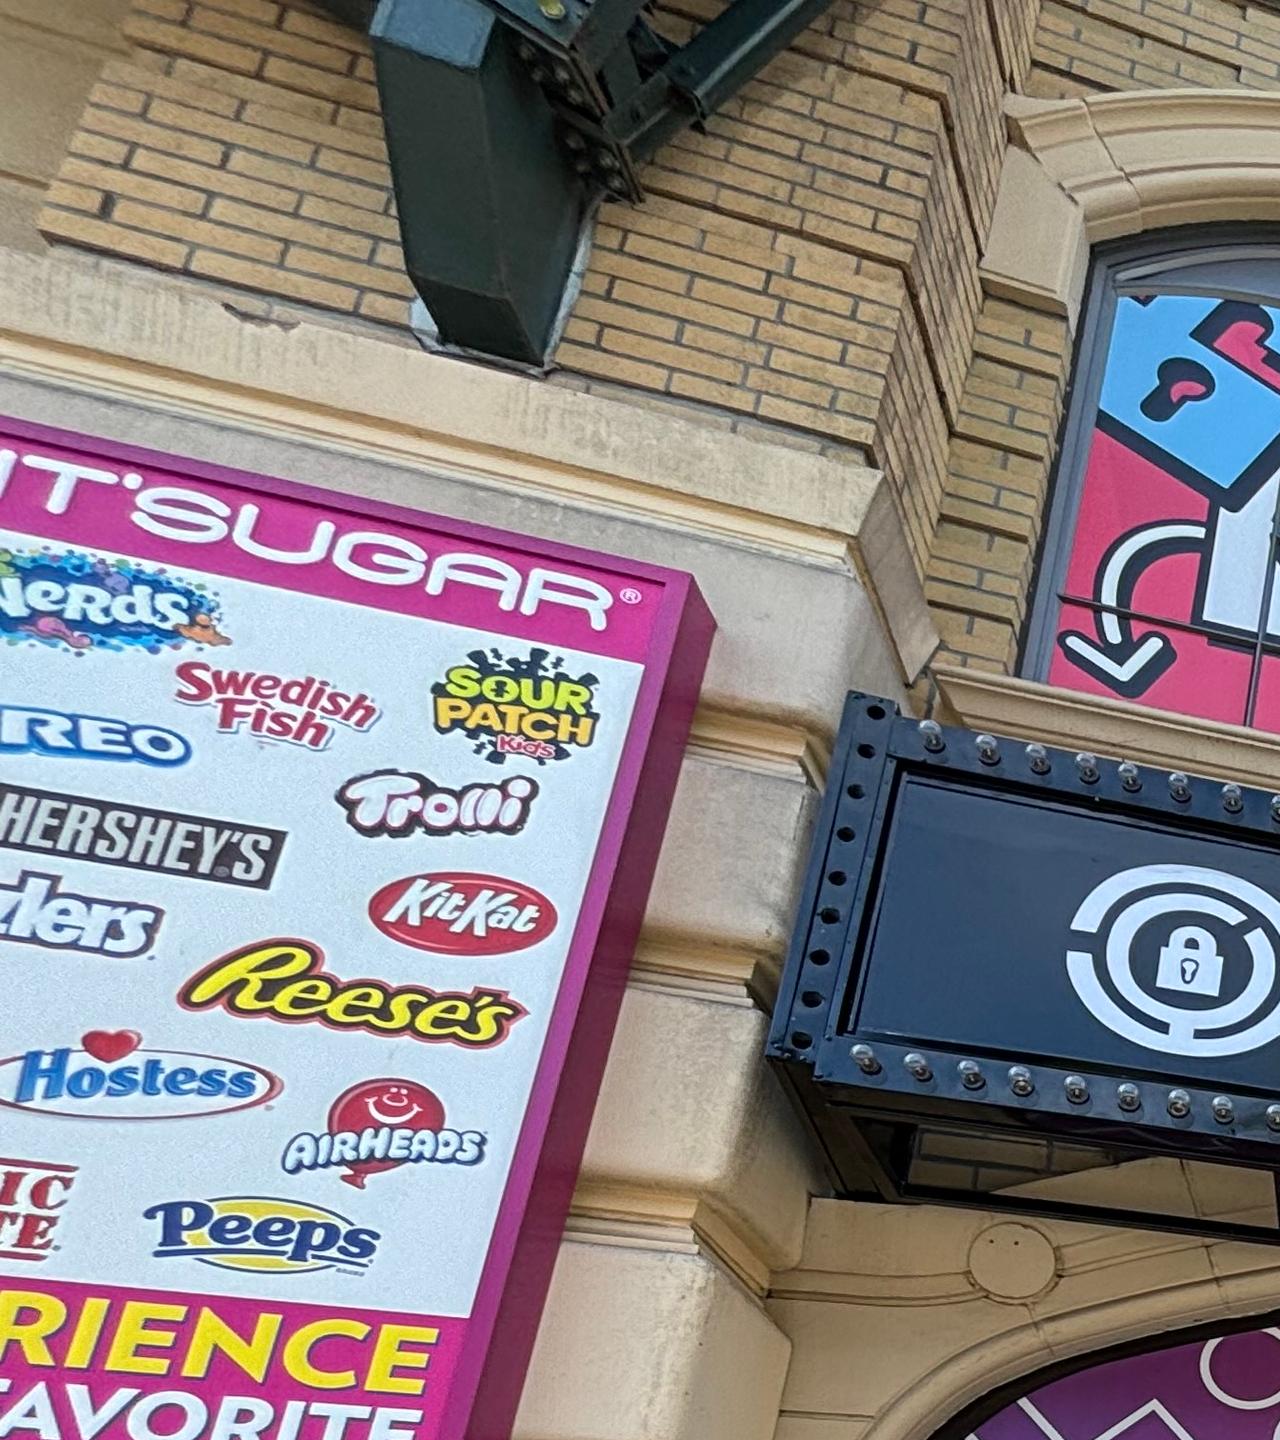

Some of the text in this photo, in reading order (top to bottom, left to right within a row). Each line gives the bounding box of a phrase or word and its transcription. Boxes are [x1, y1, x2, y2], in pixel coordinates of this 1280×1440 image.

[176, 661, 378, 728] Swedish
[445, 666, 590, 712] SOUR
[217, 700, 329, 748] Fish
[436, 696, 592, 745] PATCH
[345, 775, 536, 832] Trolli
[0, 792, 272, 882] HERSHEY'S
[190, 945, 522, 1046] Reese's
[16, 1049, 257, 1101] Hostess
[284, 1131, 486, 1174] AIRHEADS
[143, 1200, 381, 1263] Peeps
[0, 1289, 438, 1395] RIENCE
